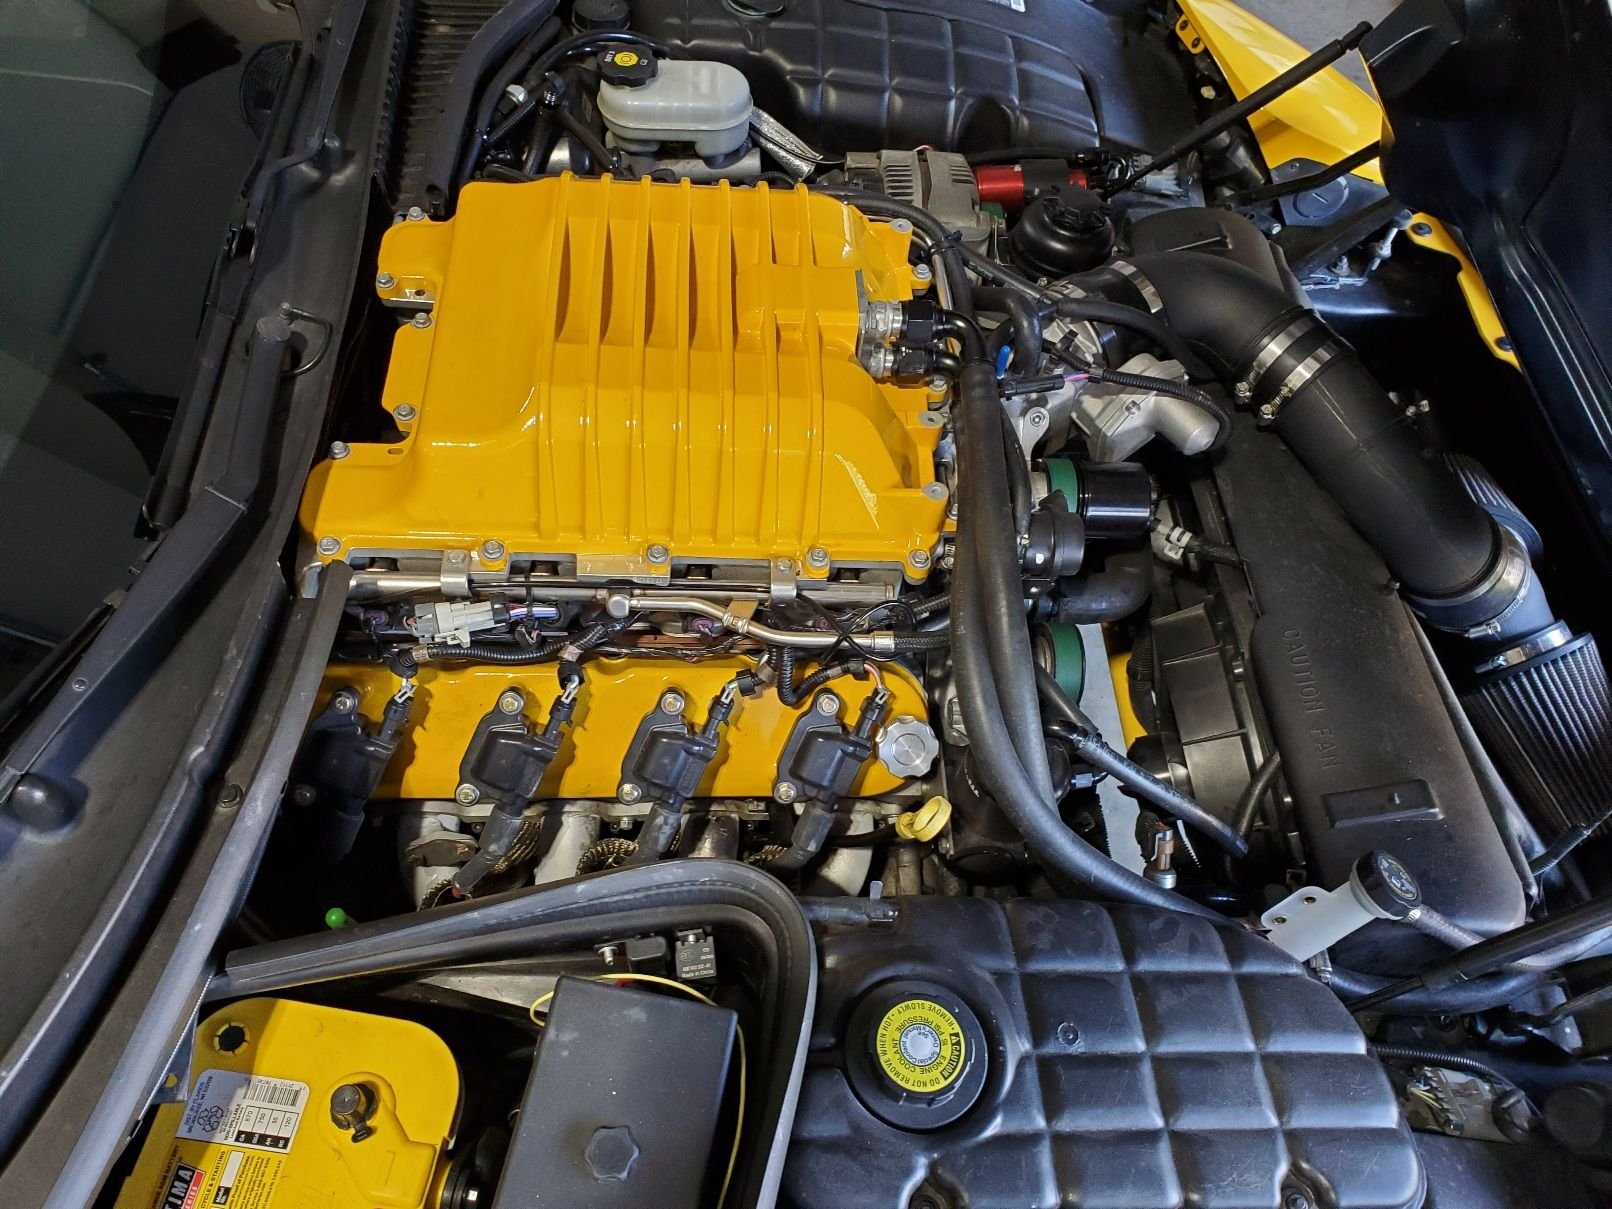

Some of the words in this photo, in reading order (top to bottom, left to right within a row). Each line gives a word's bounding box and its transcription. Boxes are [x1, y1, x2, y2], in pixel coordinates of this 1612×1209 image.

[1282, 628, 1326, 713] CAUTION
[1312, 727, 1343, 769] FAN
[897, 1003, 925, 1015] SLOWLY
[928, 1005, 954, 1028] REMOVE
[882, 1016, 893, 1031] HOT
[895, 1016, 933, 1033] PRESSURE
[903, 1026, 921, 1039] Manual
[934, 1024, 945, 1036] PSI
[893, 1039, 915, 1072] COOLANT
[902, 1041, 917, 1064] Coolant
[918, 1051, 938, 1064] Special
[941, 1045, 960, 1077] CAUTION
[884, 1058, 910, 1084] REMOVE
[920, 1056, 946, 1074] ENGINE
[912, 1079, 927, 1087] NOT
[930, 1078, 940, 1086] DO
[224, 1104, 241, 1140] NON-SPILLABLE
[201, 1189, 211, 1208] CYCLE
[211, 1151, 225, 1182] STARTING
